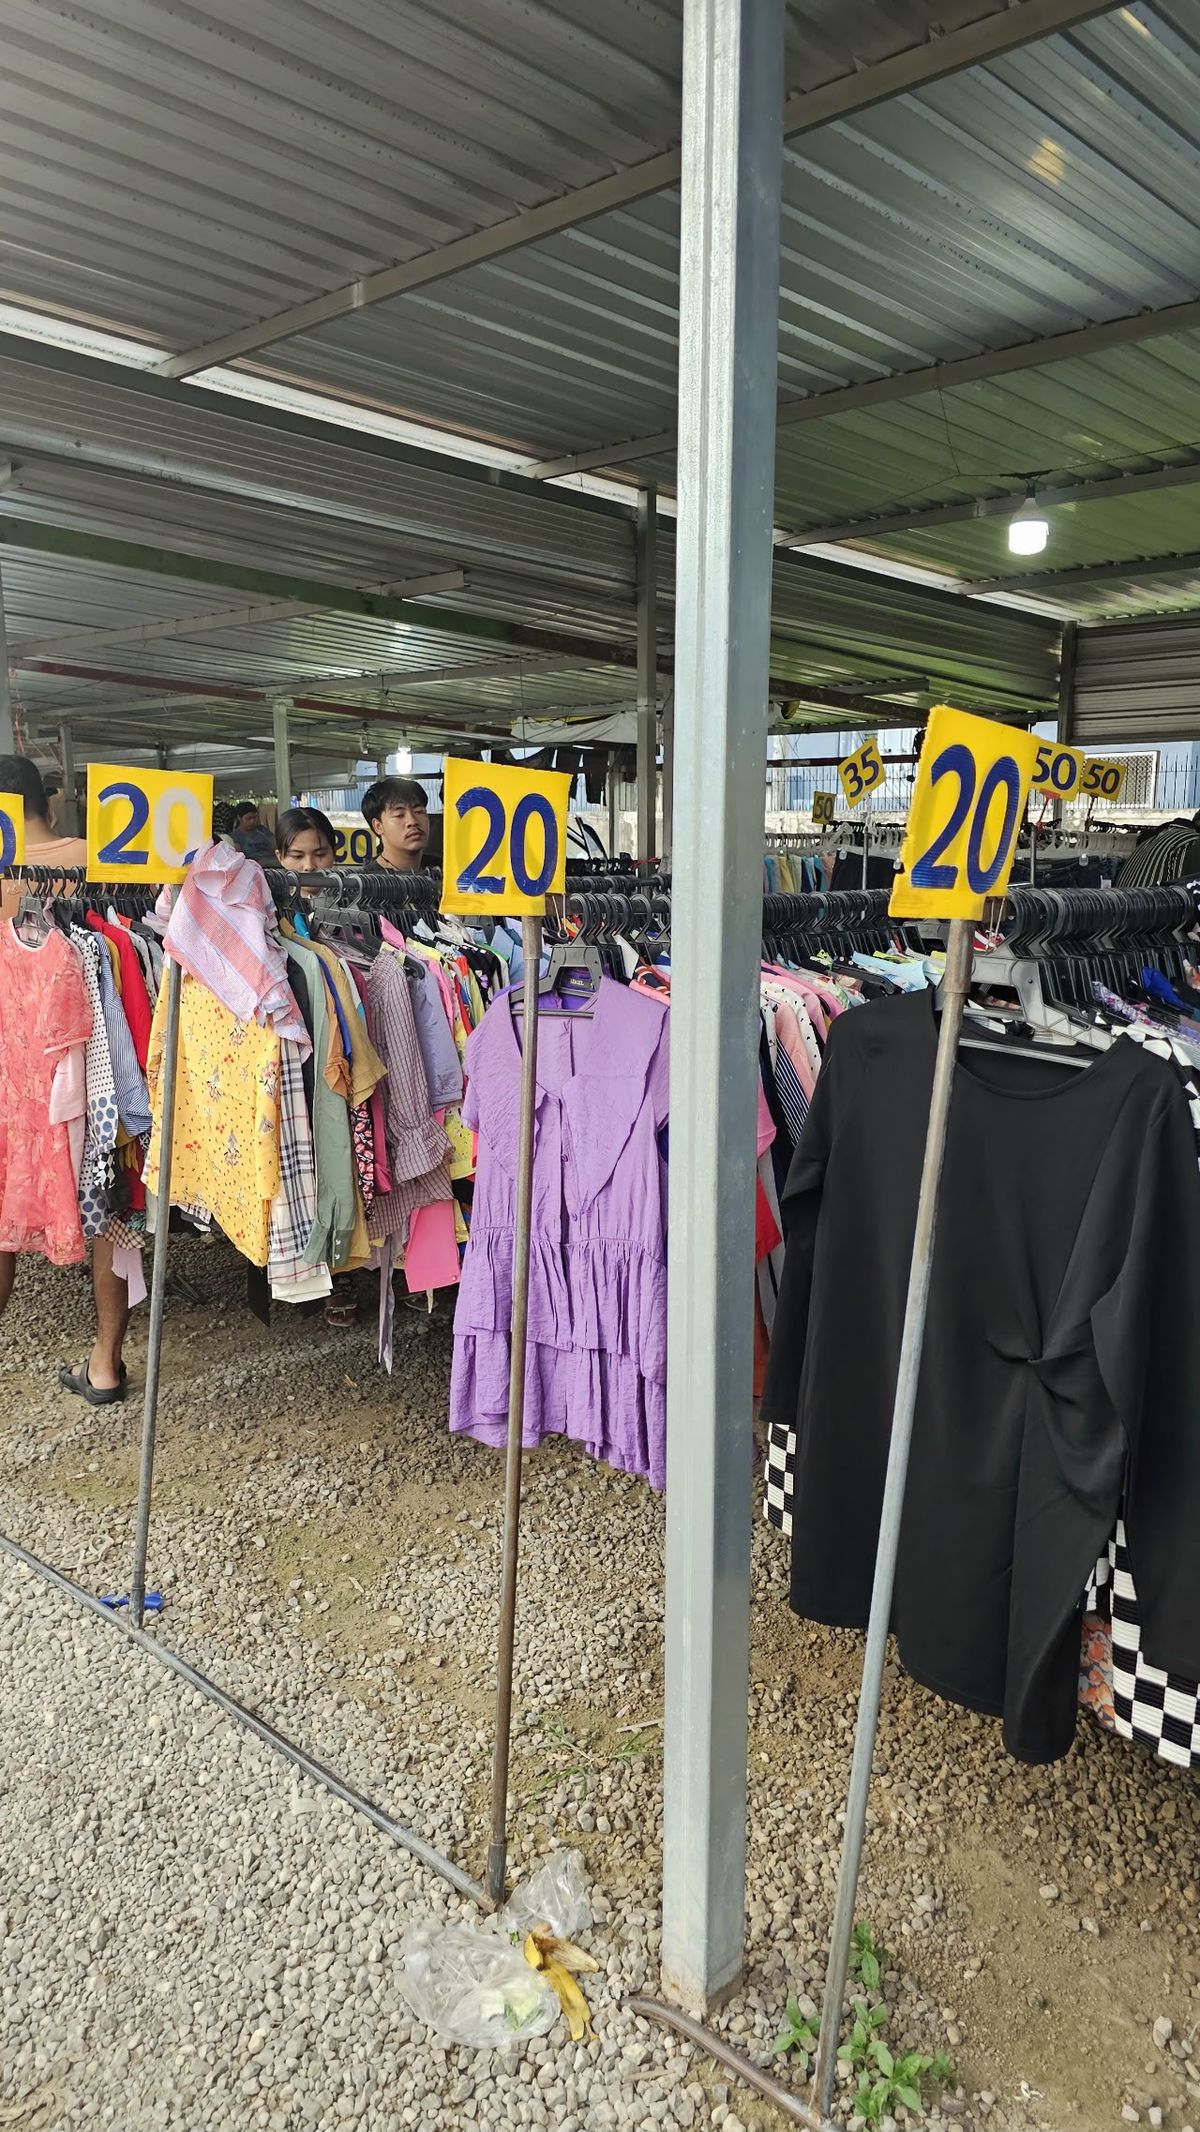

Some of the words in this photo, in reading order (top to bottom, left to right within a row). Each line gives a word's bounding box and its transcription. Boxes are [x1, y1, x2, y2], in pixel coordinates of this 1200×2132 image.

[844, 746, 880, 798] 35
[1031, 746, 1077, 791] 50
[1083, 763, 1121, 794] 50
[98, 782, 204, 868] 20
[814, 795, 834, 819] 50
[911, 744, 1020, 894] 20
[457, 787, 558, 897] 20
